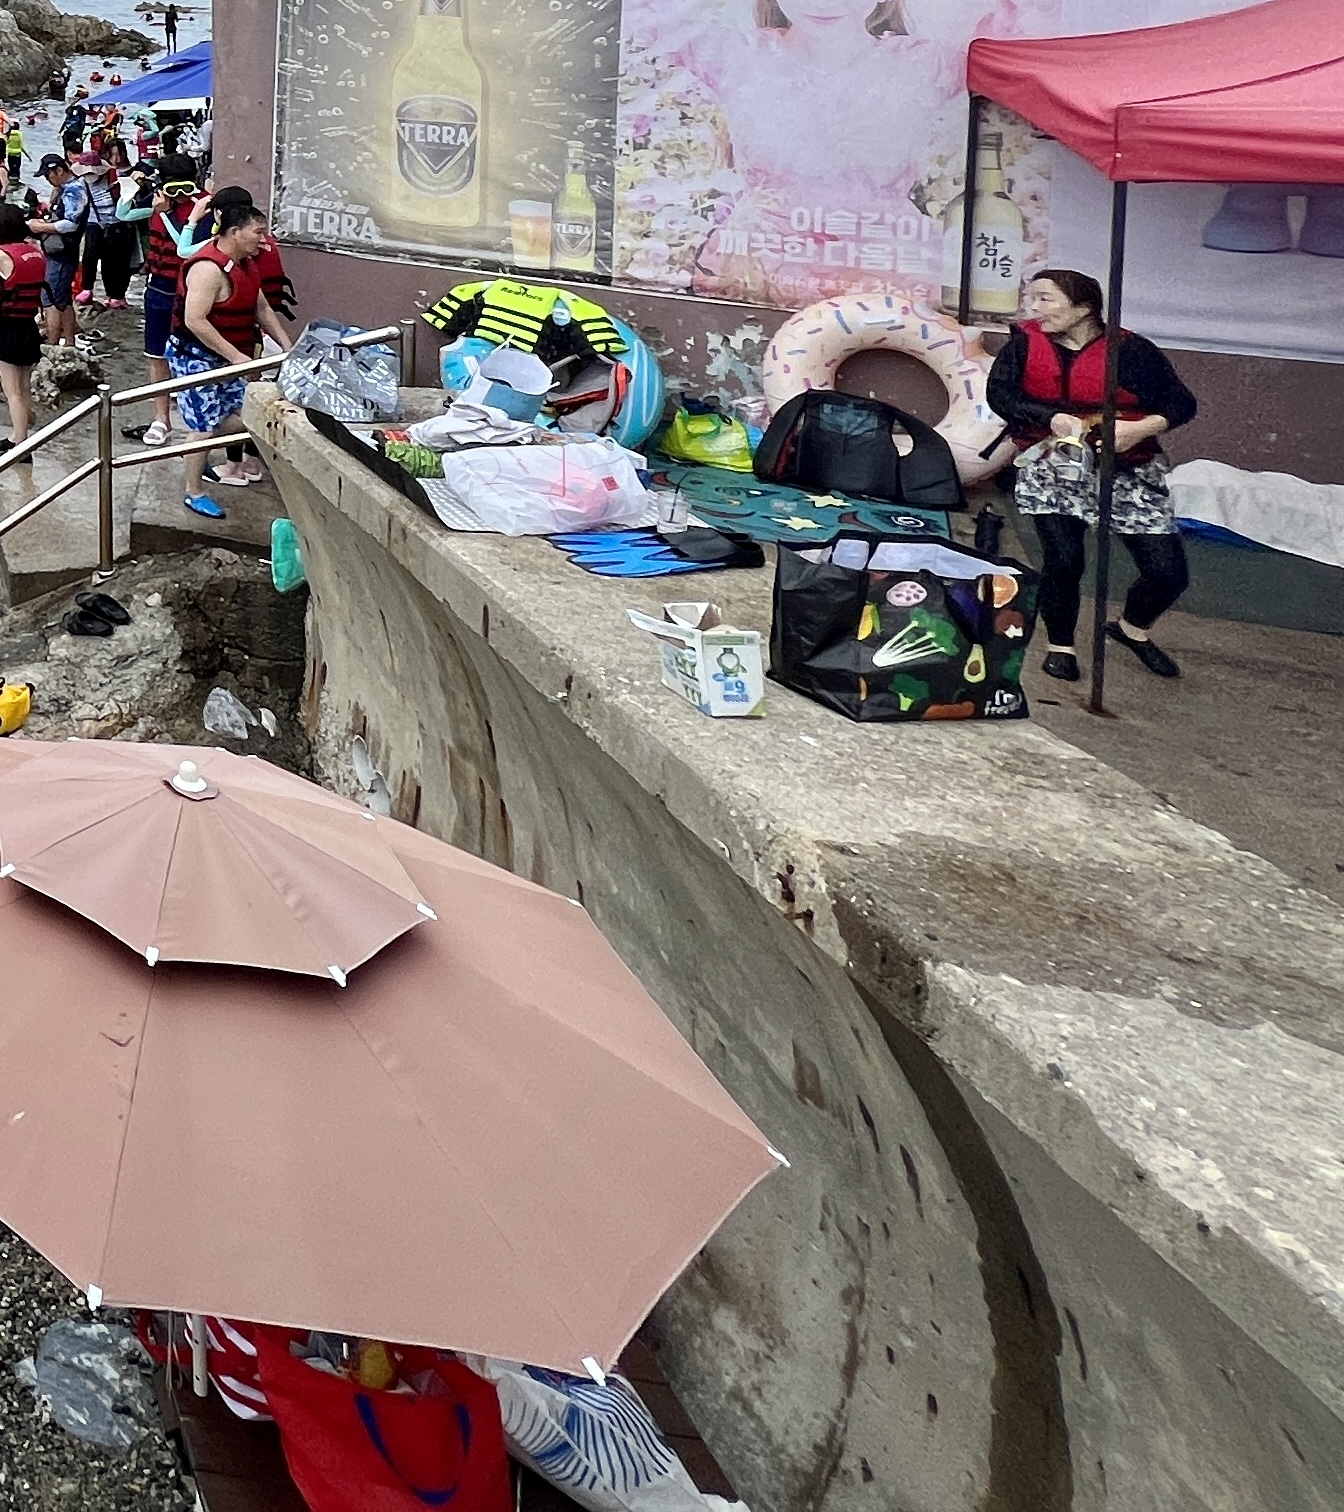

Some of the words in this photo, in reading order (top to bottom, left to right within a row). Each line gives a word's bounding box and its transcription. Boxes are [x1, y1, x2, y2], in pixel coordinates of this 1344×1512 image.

[400, 122, 472, 147] TERRA
[286, 204, 379, 241] TERRA
[555, 223, 592, 236] TERRA
[790, 206, 932, 242] 이슬같이
[717, 229, 818, 263] 깨끗한
[975, 233, 1005, 257] 참
[978, 255, 1014, 278] 이슬
